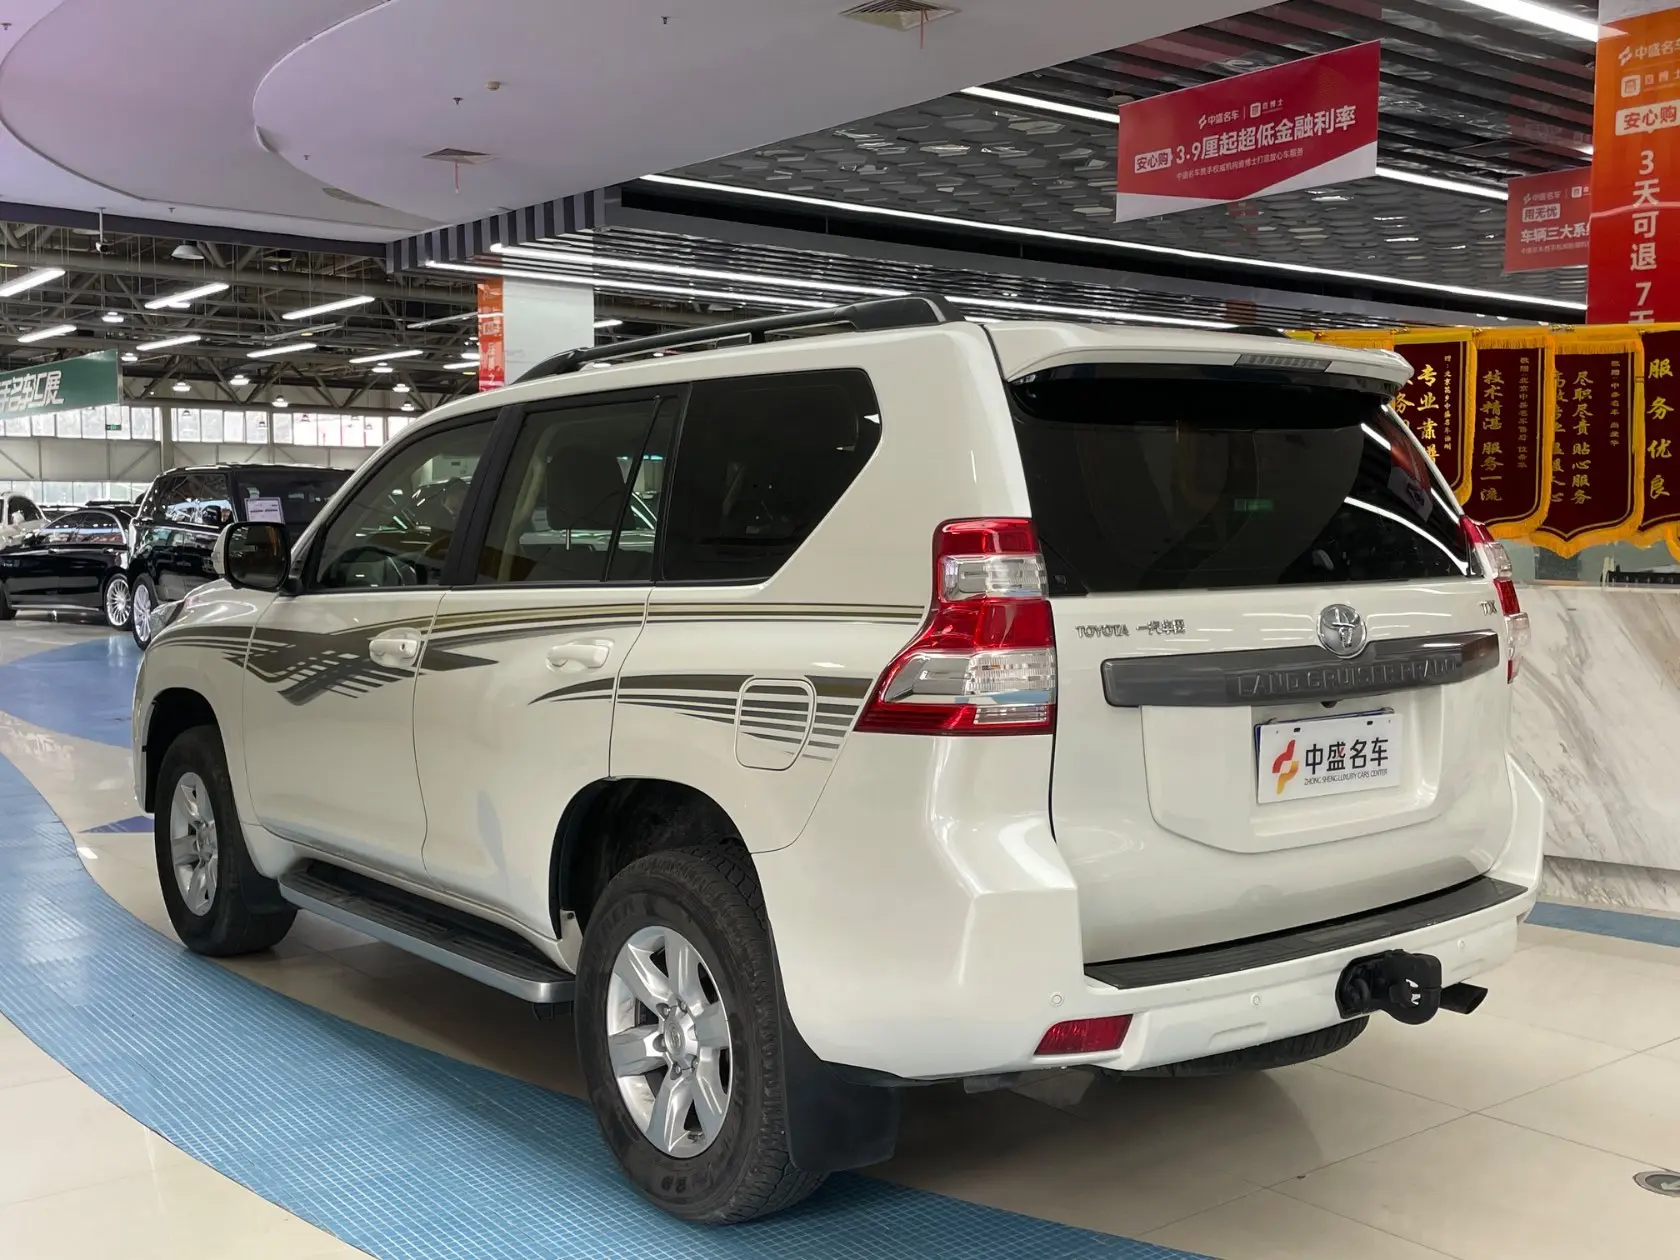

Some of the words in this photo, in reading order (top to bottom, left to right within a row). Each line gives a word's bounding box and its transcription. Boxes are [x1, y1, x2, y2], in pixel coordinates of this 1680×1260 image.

[1624, 105, 1677, 130] 安心购
[1176, 105, 1356, 165] 3.9厘起超低金融利率
[1136, 150, 1170, 172] 安心购
[1075, 624, 1130, 638] TOYOTA
[1238, 671, 1299, 697] LAND
[1305, 737, 1389, 775] 中盛名车
[1370, 768, 1388, 778] CENTER
